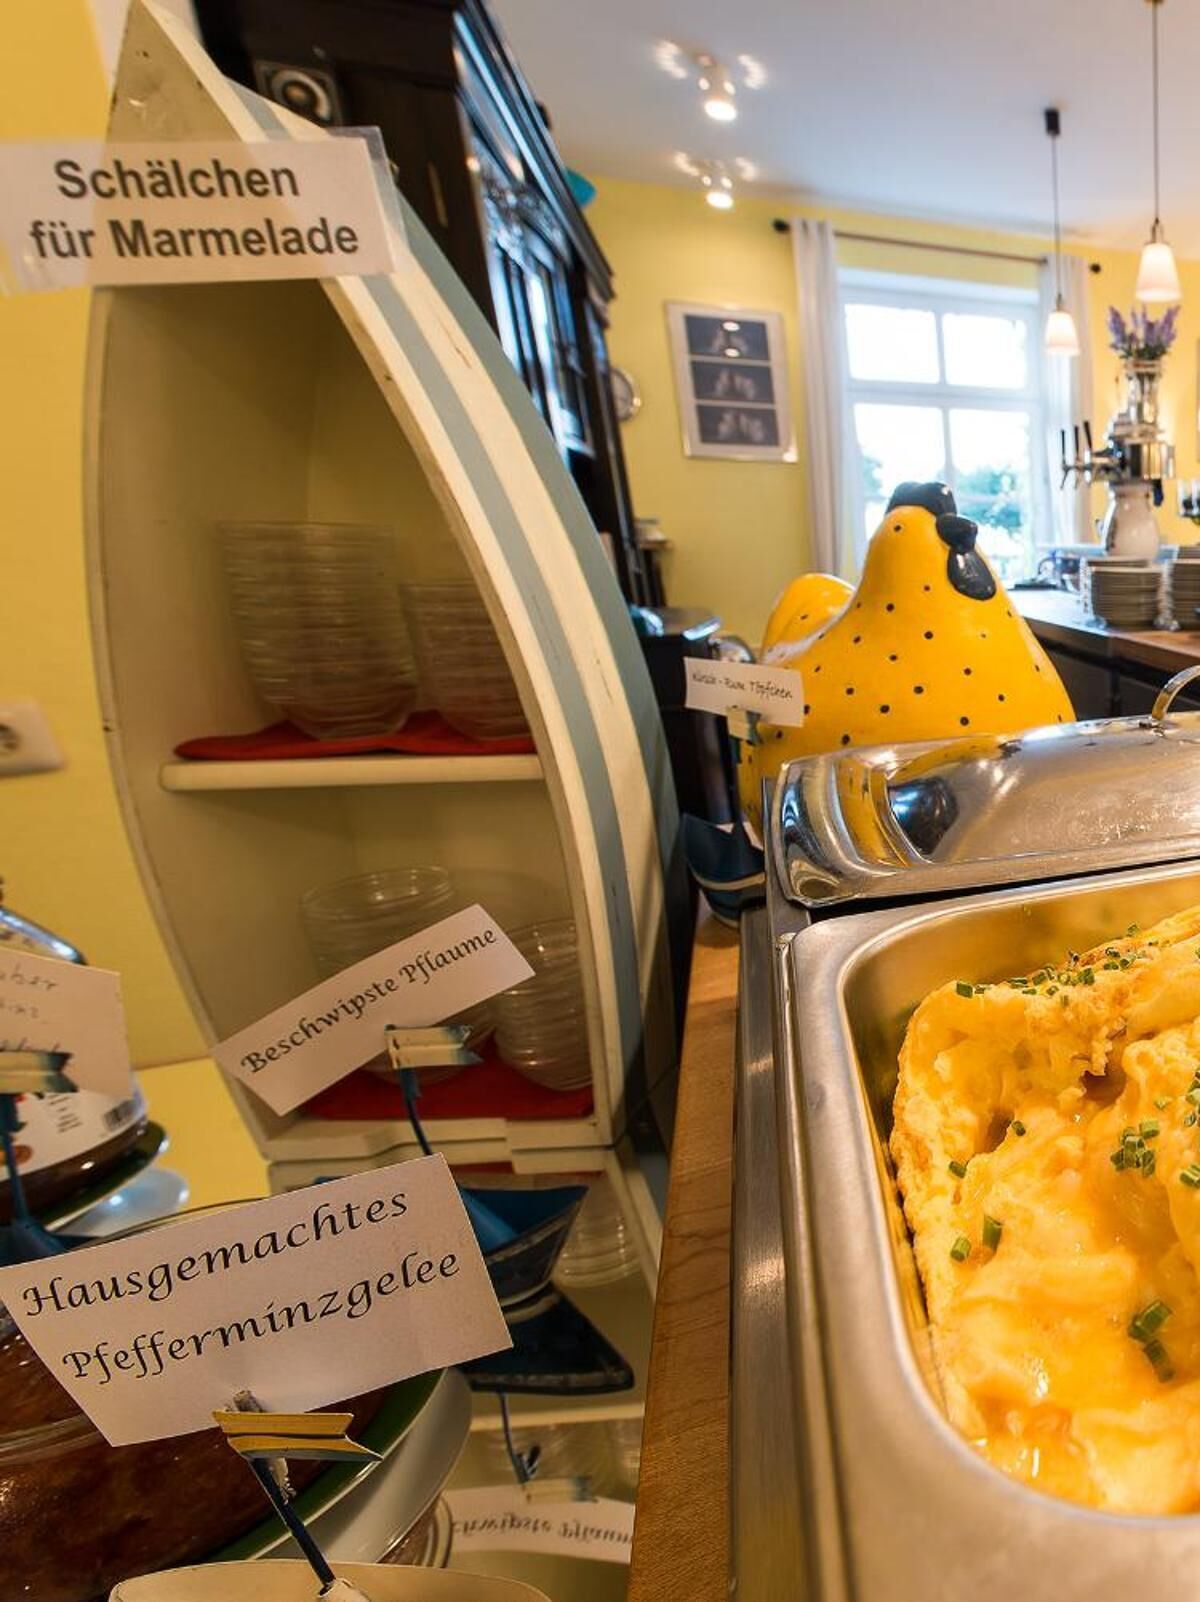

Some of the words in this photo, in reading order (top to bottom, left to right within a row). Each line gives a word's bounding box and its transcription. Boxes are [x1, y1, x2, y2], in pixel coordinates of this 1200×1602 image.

[30, 219, 95, 258] für
[107, 217, 358, 258] Marmelade
[54, 159, 300, 199] Schälchen
[240, 976, 398, 1073] Beschwipste
[399, 929, 497, 985] Pflaume
[22, 1191, 408, 1317] Hausgemachtes
[62, 1250, 460, 1385] Pfefferminzgelee
